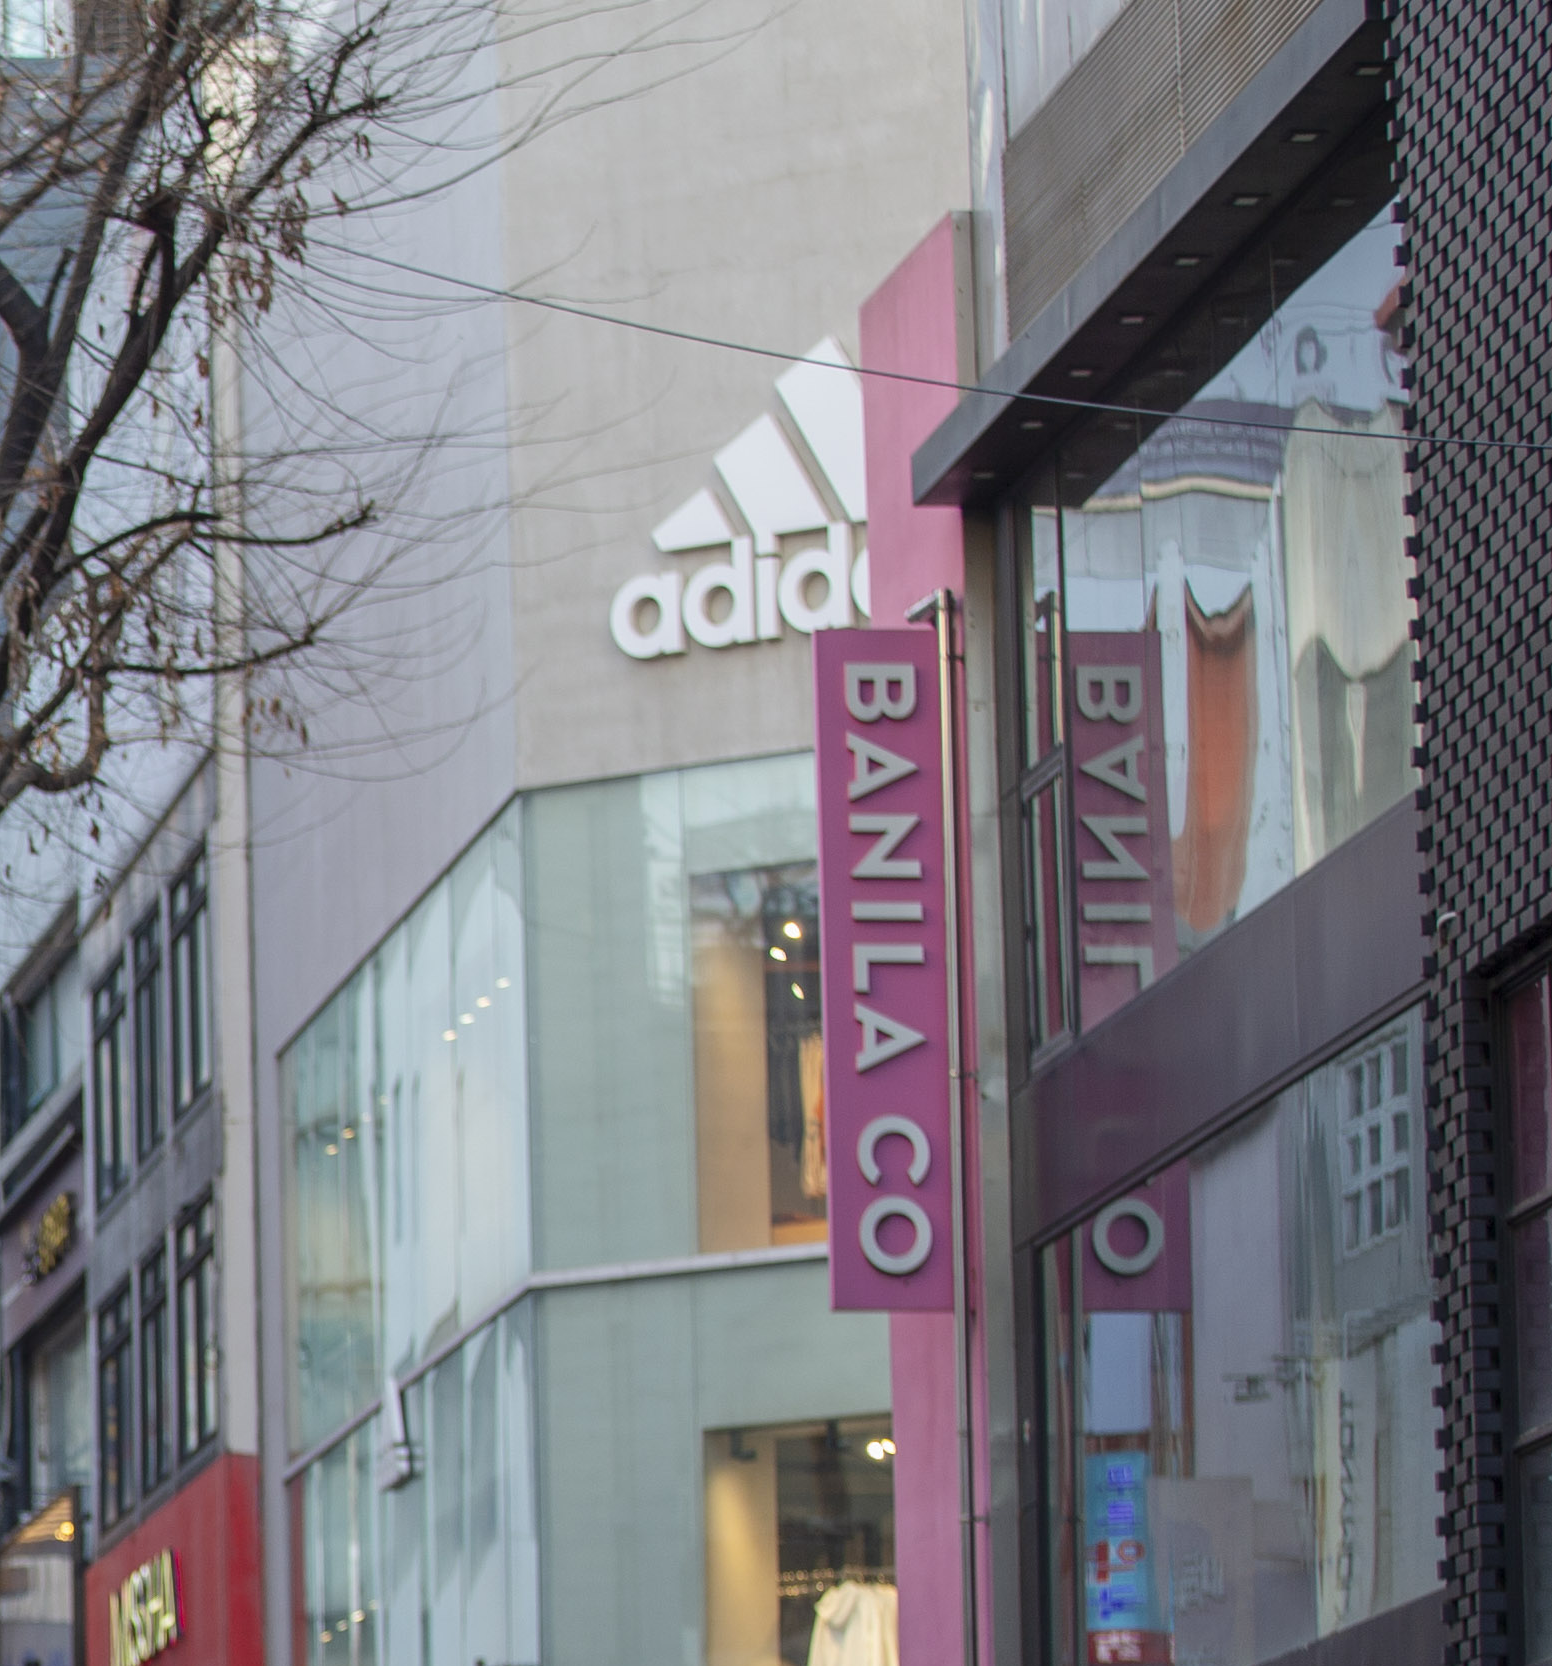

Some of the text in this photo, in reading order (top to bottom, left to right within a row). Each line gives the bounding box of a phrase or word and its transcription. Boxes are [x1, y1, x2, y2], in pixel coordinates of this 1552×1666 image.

[609, 522, 871, 661] adid
[843, 661, 933, 1276] BANILA CO
